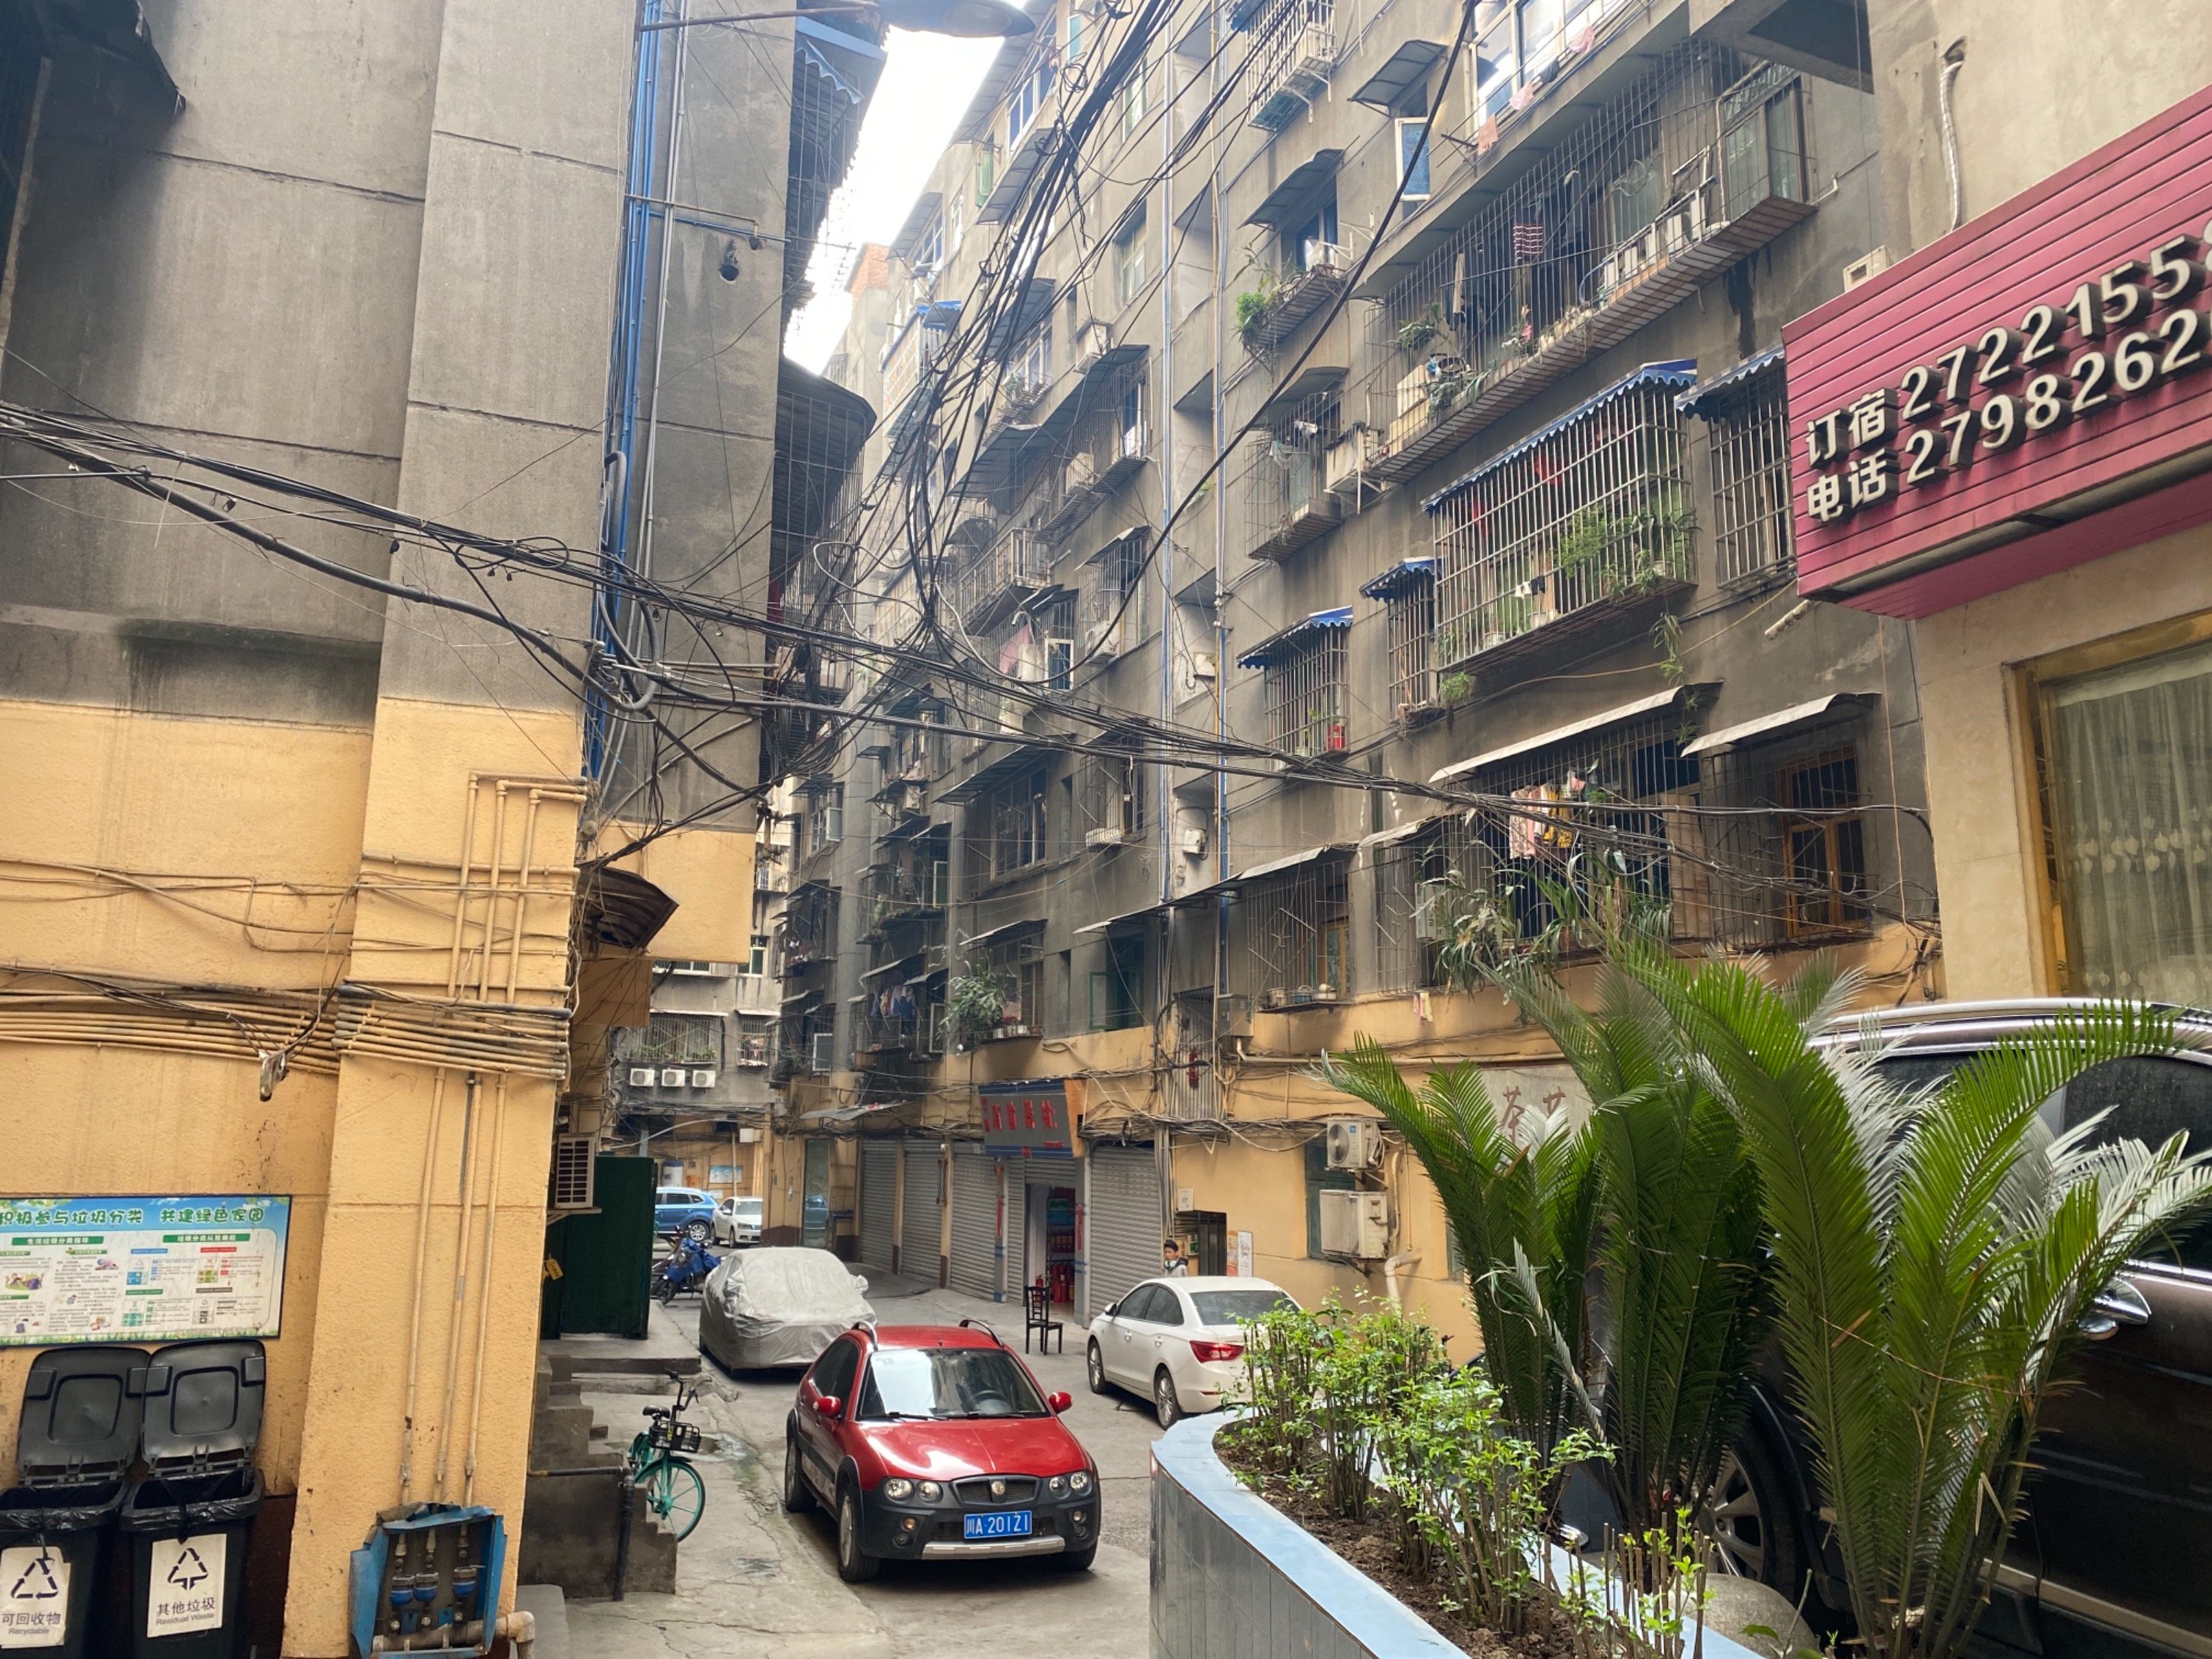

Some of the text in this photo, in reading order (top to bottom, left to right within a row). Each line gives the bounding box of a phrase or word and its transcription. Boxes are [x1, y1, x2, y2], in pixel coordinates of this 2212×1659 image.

[1805, 217, 2212, 468] 订宿 2722155
[1807, 449, 1888, 522] 电话
[160, 1207, 264, 1223] 共建绿色家园
[156, 1597, 215, 1616] 其他垃圾
[2, 1611, 61, 1626] 可回收物
[156, 1612, 215, 1625] Residual Waste
